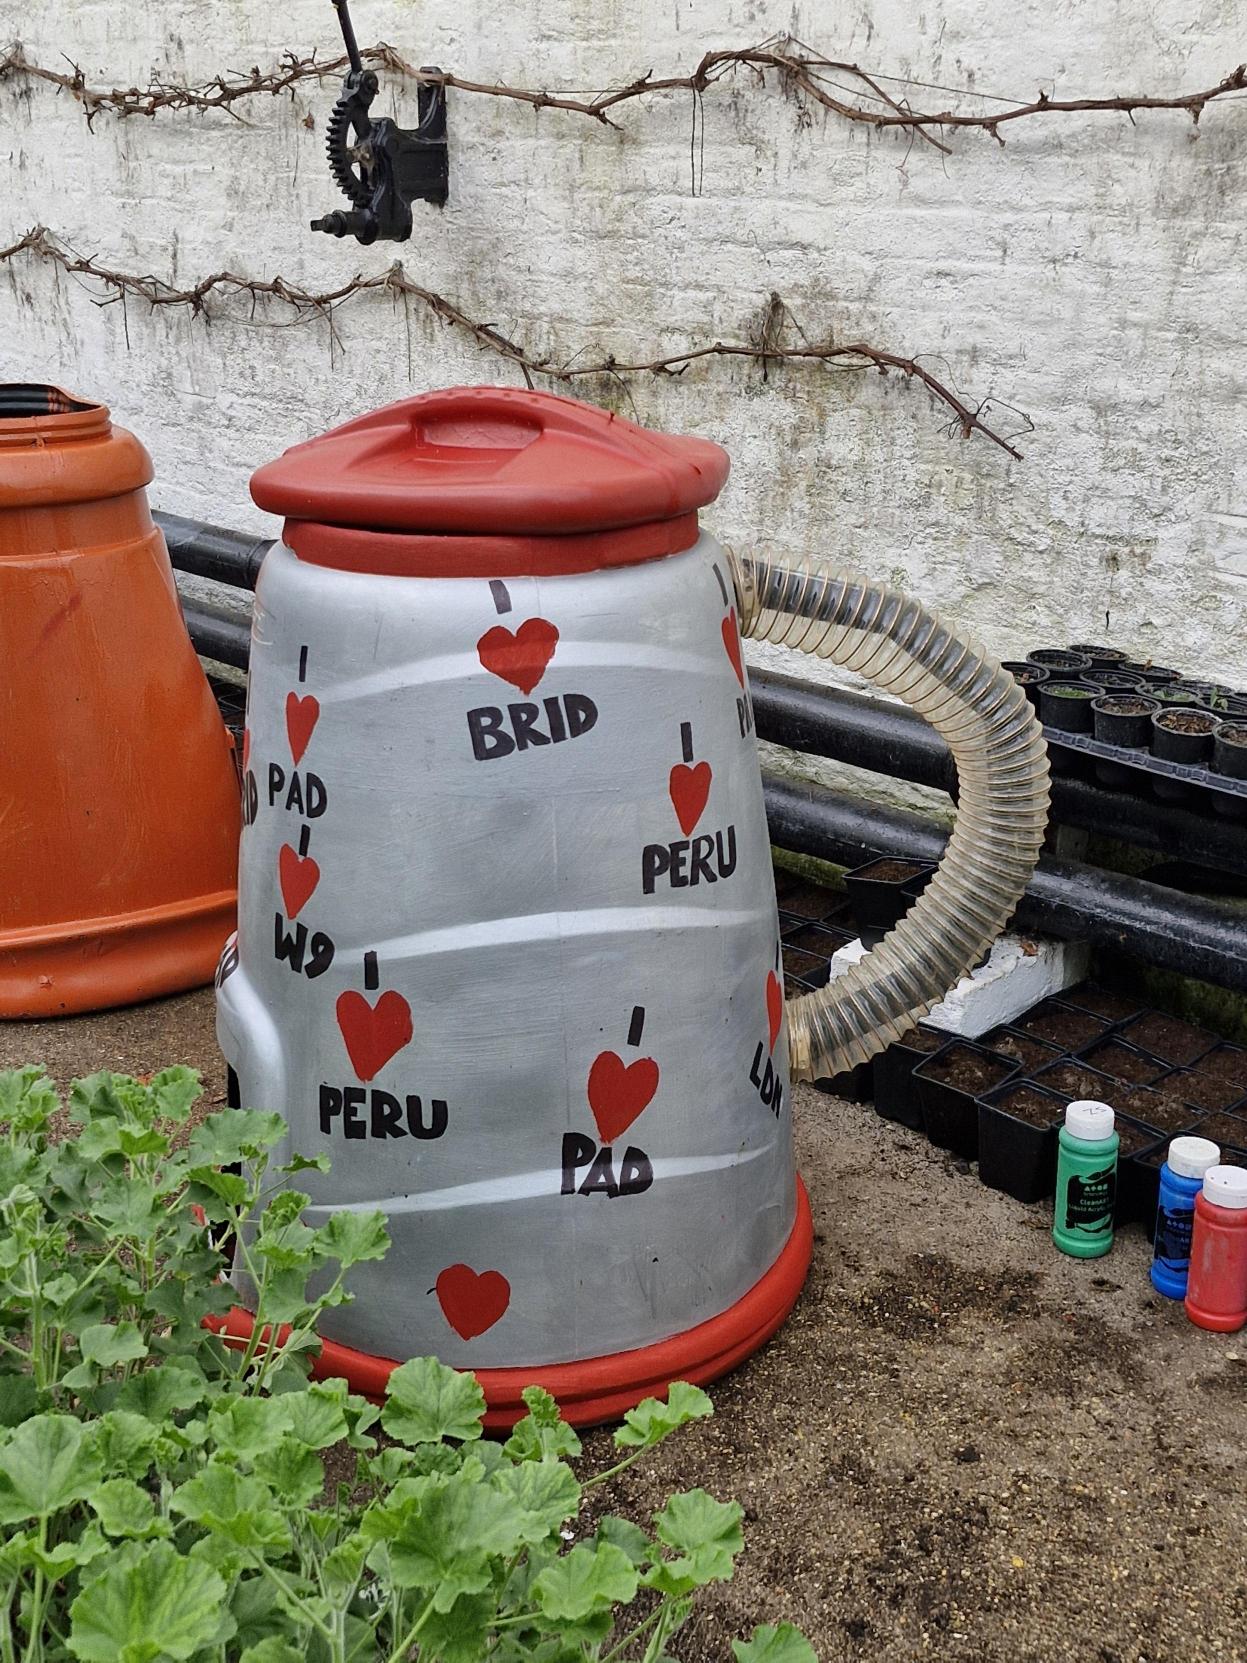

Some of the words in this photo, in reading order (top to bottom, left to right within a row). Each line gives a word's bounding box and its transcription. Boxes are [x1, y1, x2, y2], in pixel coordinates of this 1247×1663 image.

[489, 580, 512, 615] I
[298, 645, 309, 683] I
[467, 693, 599, 762] BRID
[680, 721, 694, 764] I
[268, 762, 328, 819] PAD
[298, 823, 311, 858] I
[641, 824, 738, 895] PERU
[274, 911, 336, 980] W9
[363, 950, 380, 991] I
[627, 1005, 646, 1048] I
[319, 1082, 449, 1140] PERU
[561, 1131, 655, 1200] PAD
